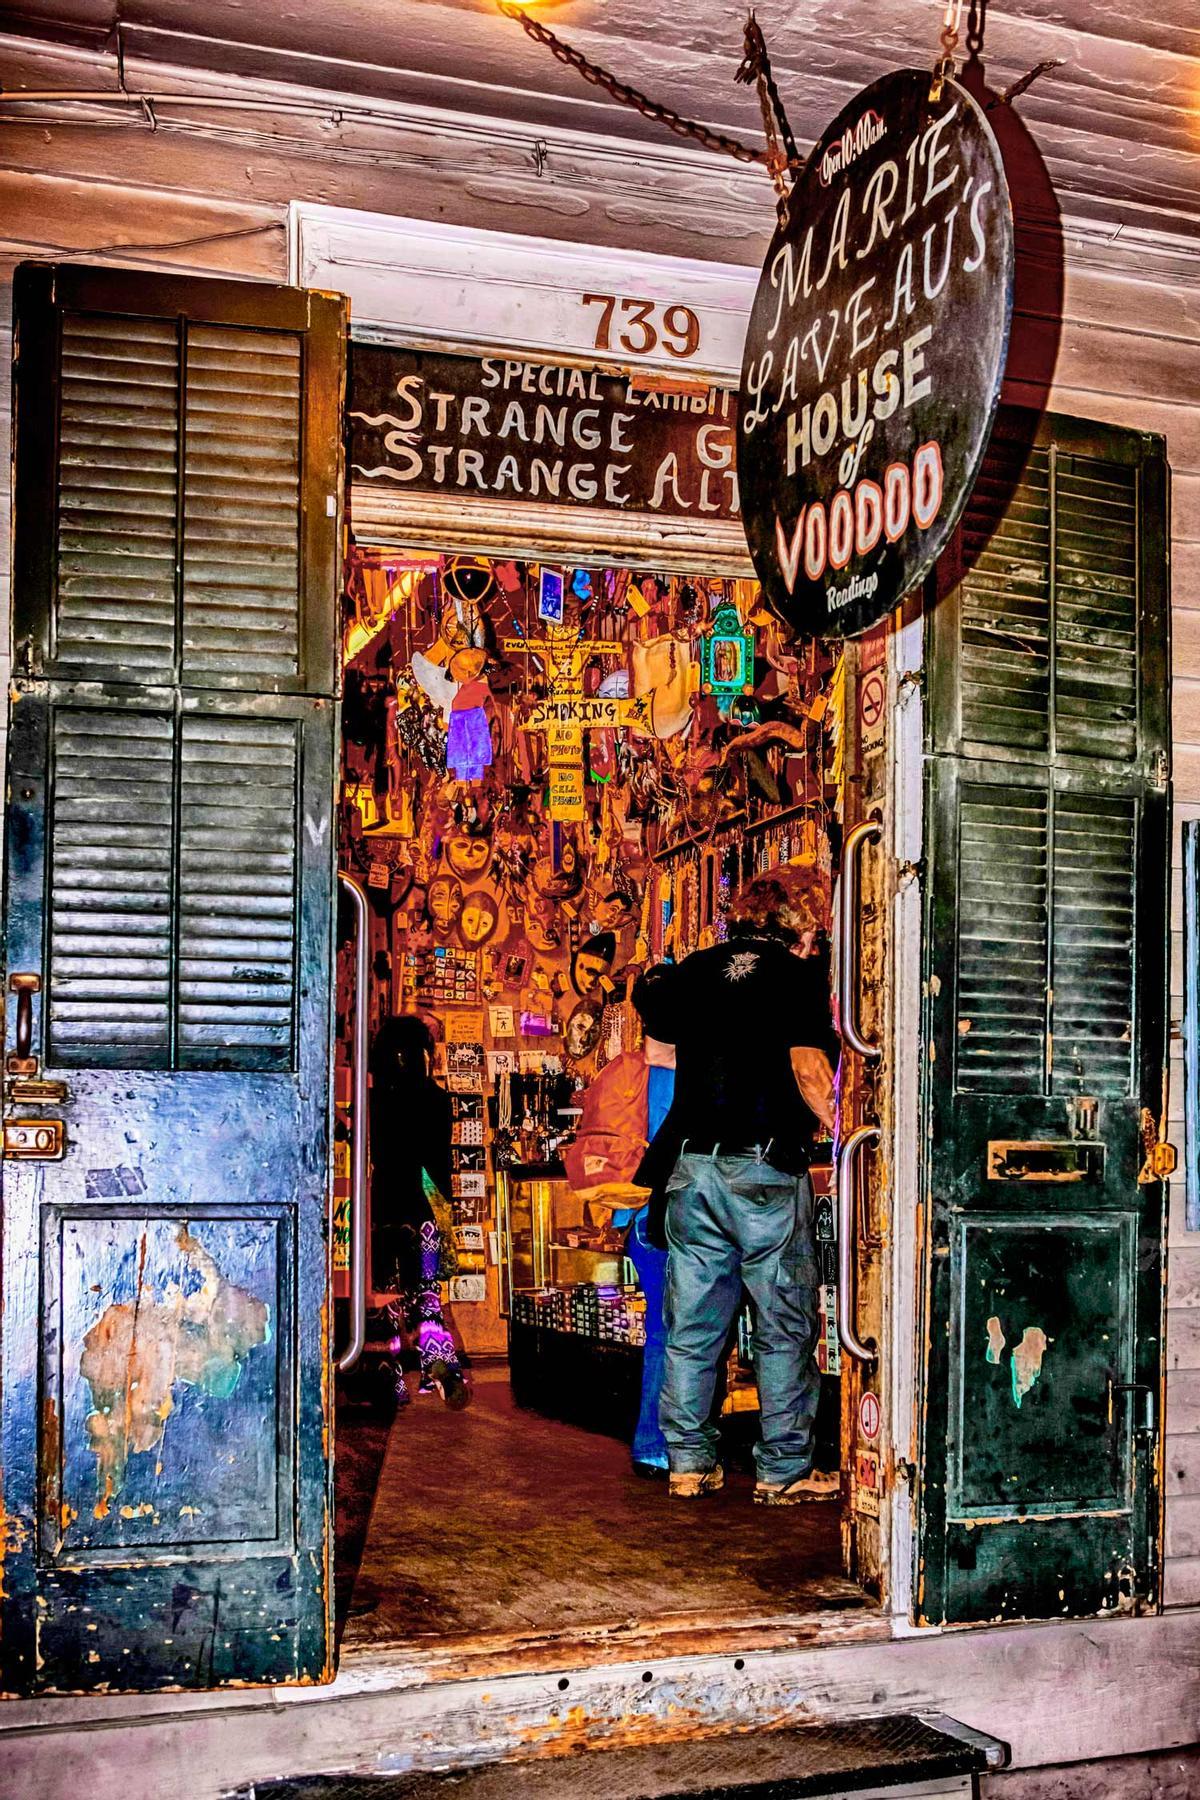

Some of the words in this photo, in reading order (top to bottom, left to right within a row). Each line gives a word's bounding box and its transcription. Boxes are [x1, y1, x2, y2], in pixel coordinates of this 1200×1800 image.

[822, 152, 841, 184] Open
[767, 103, 958, 340] MARIE
[582, 293, 701, 358] 739
[481, 358, 604, 400] SPECIAL
[785, 325, 933, 476] HOUSE
[349, 375, 635, 453] STRANGE
[350, 430, 632, 504] STRANGE
[839, 418, 875, 489] of
[775, 440, 944, 596] VOODOO
[826, 571, 879, 612] Readings
[533, 699, 617, 723] SMOKING
[555, 729, 573, 742] NO
